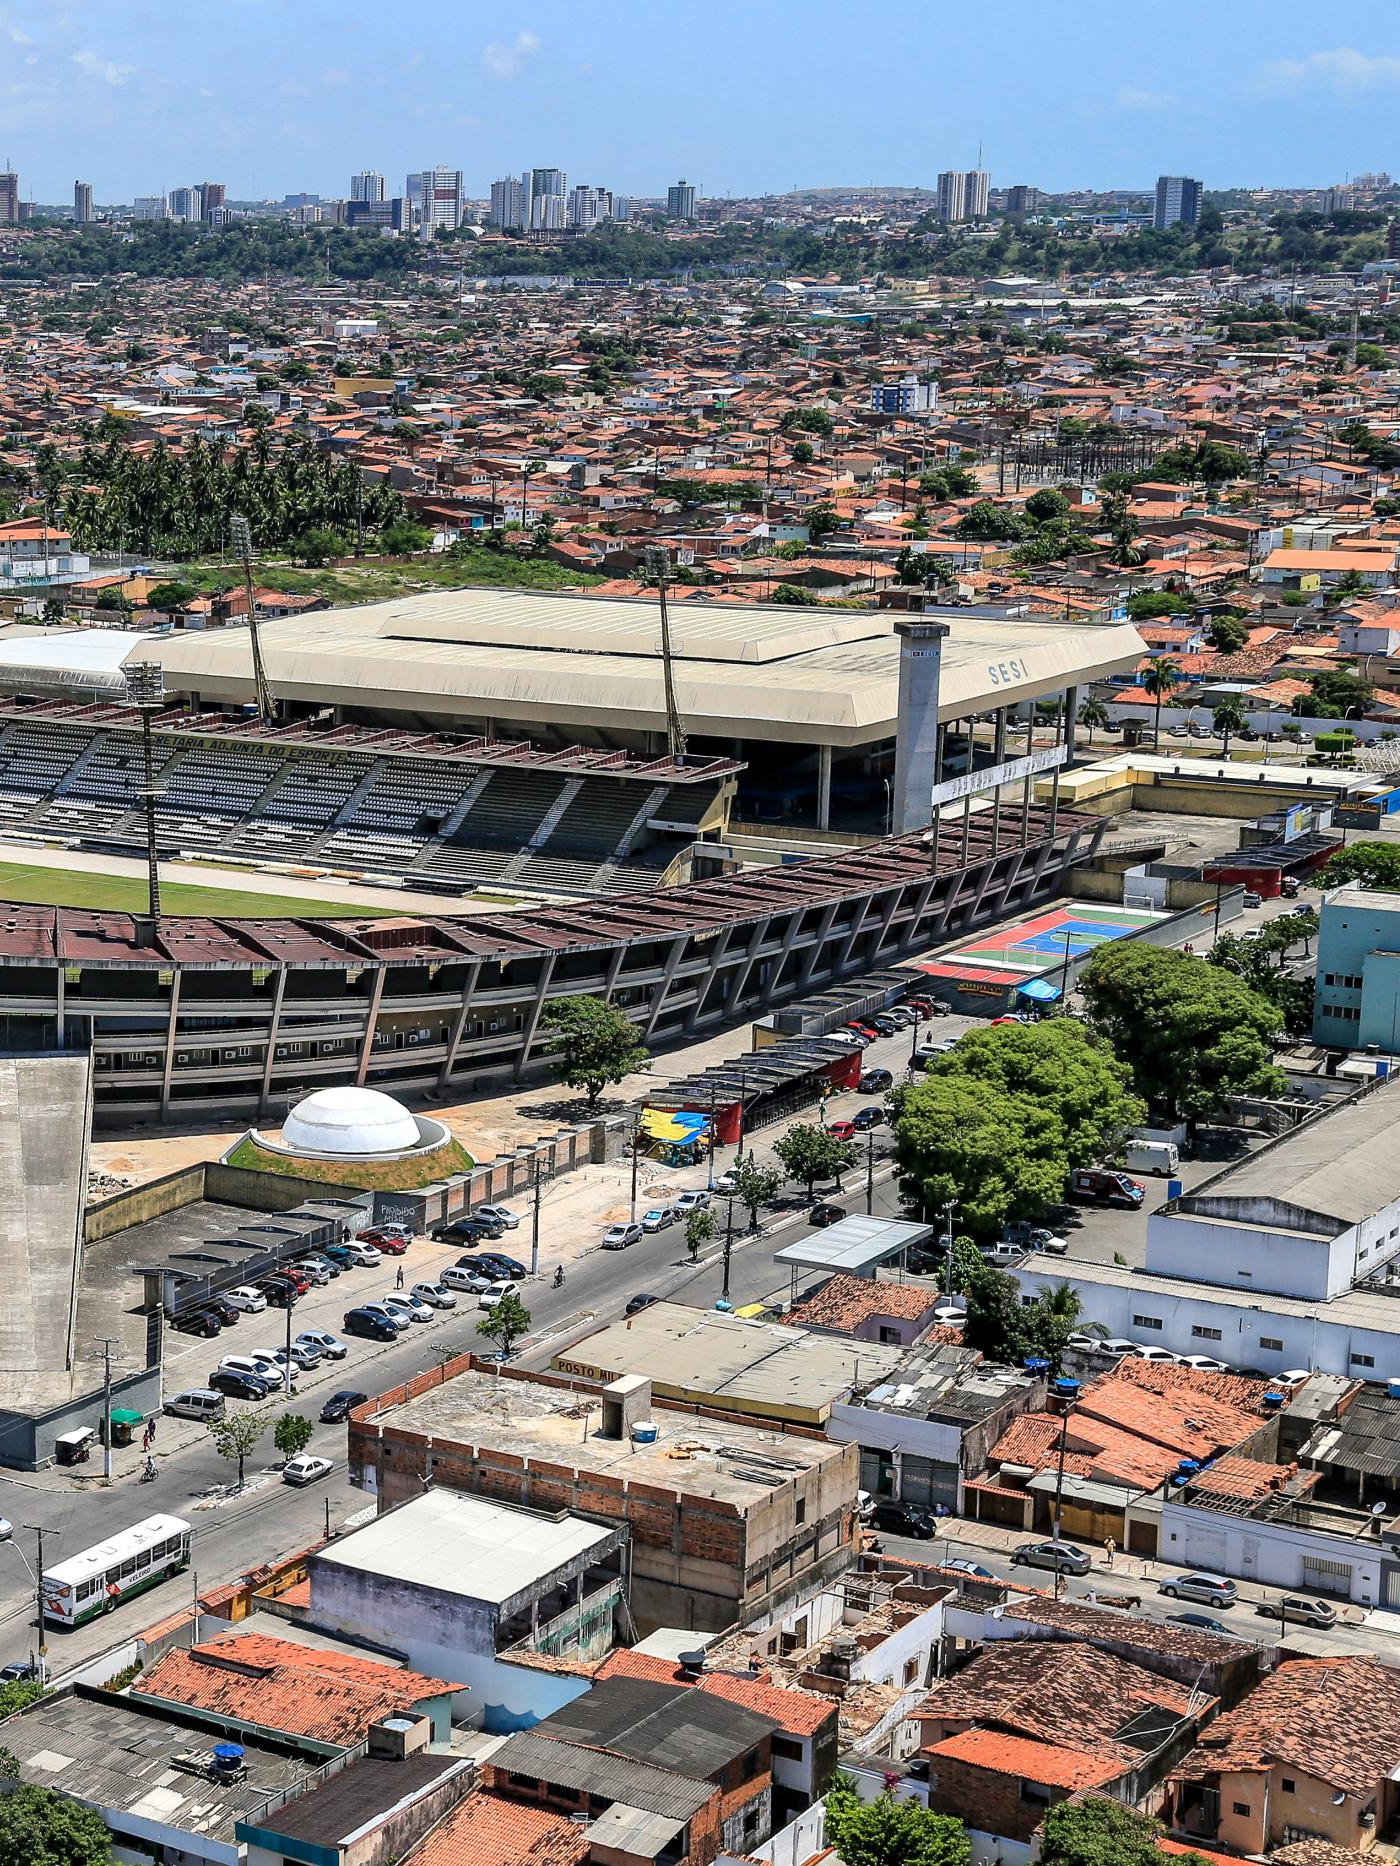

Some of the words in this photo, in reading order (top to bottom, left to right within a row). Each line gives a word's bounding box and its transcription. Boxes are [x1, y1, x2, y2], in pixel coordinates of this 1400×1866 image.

[988, 658, 1028, 685] SESI
[209, 740, 264, 753] ADJUNTA
[269, 745, 285, 756] DO
[289, 748, 346, 763] ESPORTE
[558, 1361, 595, 1377] POSTO
[129, 1567, 151, 1583] VELEIRO
